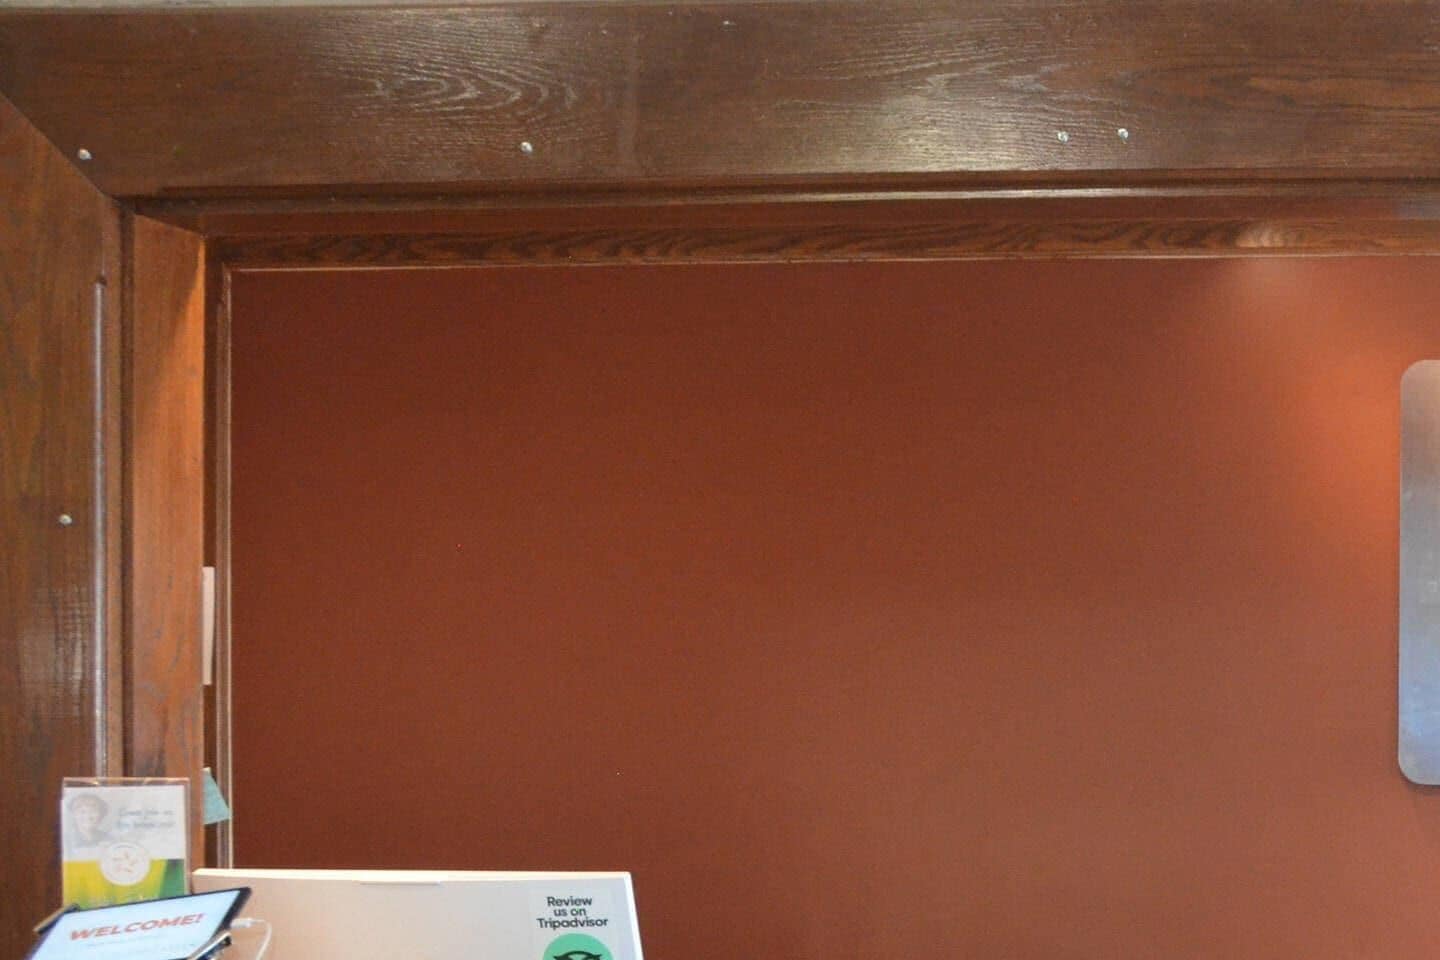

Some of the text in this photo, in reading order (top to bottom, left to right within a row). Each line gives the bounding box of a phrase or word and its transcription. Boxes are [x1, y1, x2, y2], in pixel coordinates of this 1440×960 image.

[547, 896, 593, 906] Review
[553, 907, 587, 917] us on
[70, 912, 206, 941] WELCOME!
[536, 917, 609, 931] Tripadvisor
